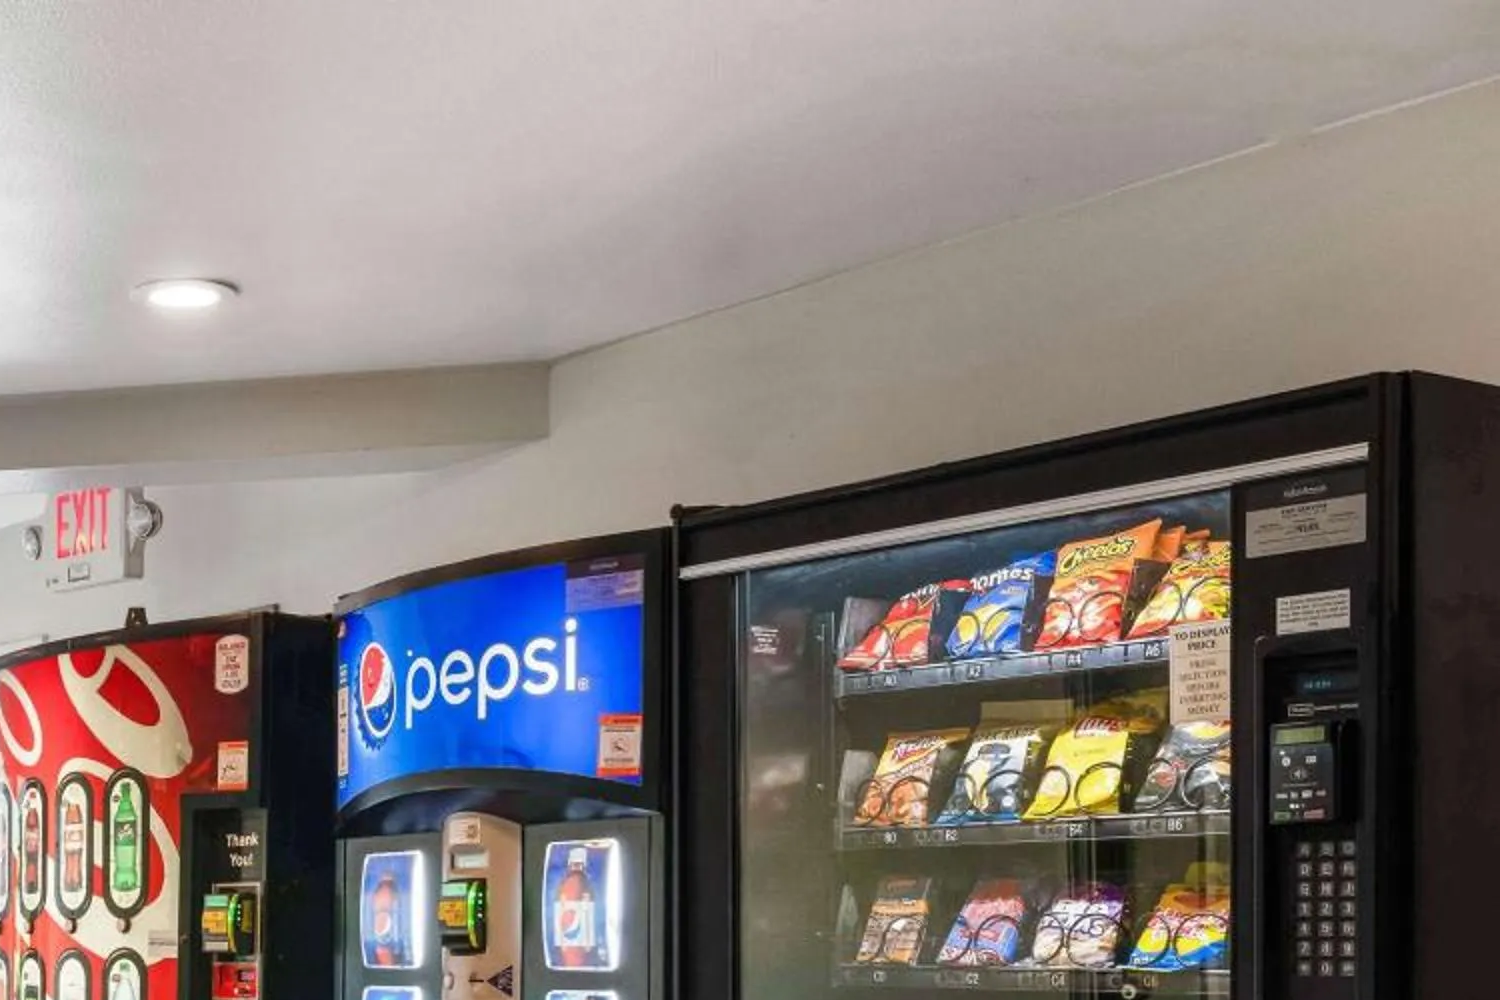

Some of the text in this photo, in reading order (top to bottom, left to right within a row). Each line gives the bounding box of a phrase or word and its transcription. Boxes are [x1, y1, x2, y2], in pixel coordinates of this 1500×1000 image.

[56, 487, 111, 559] EXIT
[1059, 537, 1136, 574] Cheetos
[1174, 625, 1231, 641] TO DISPLAY
[1187, 640, 1216, 650] PRICE
[404, 618, 578, 730] pepsi
[226, 832, 259, 848] Thank
[229, 853, 254, 867] You!
